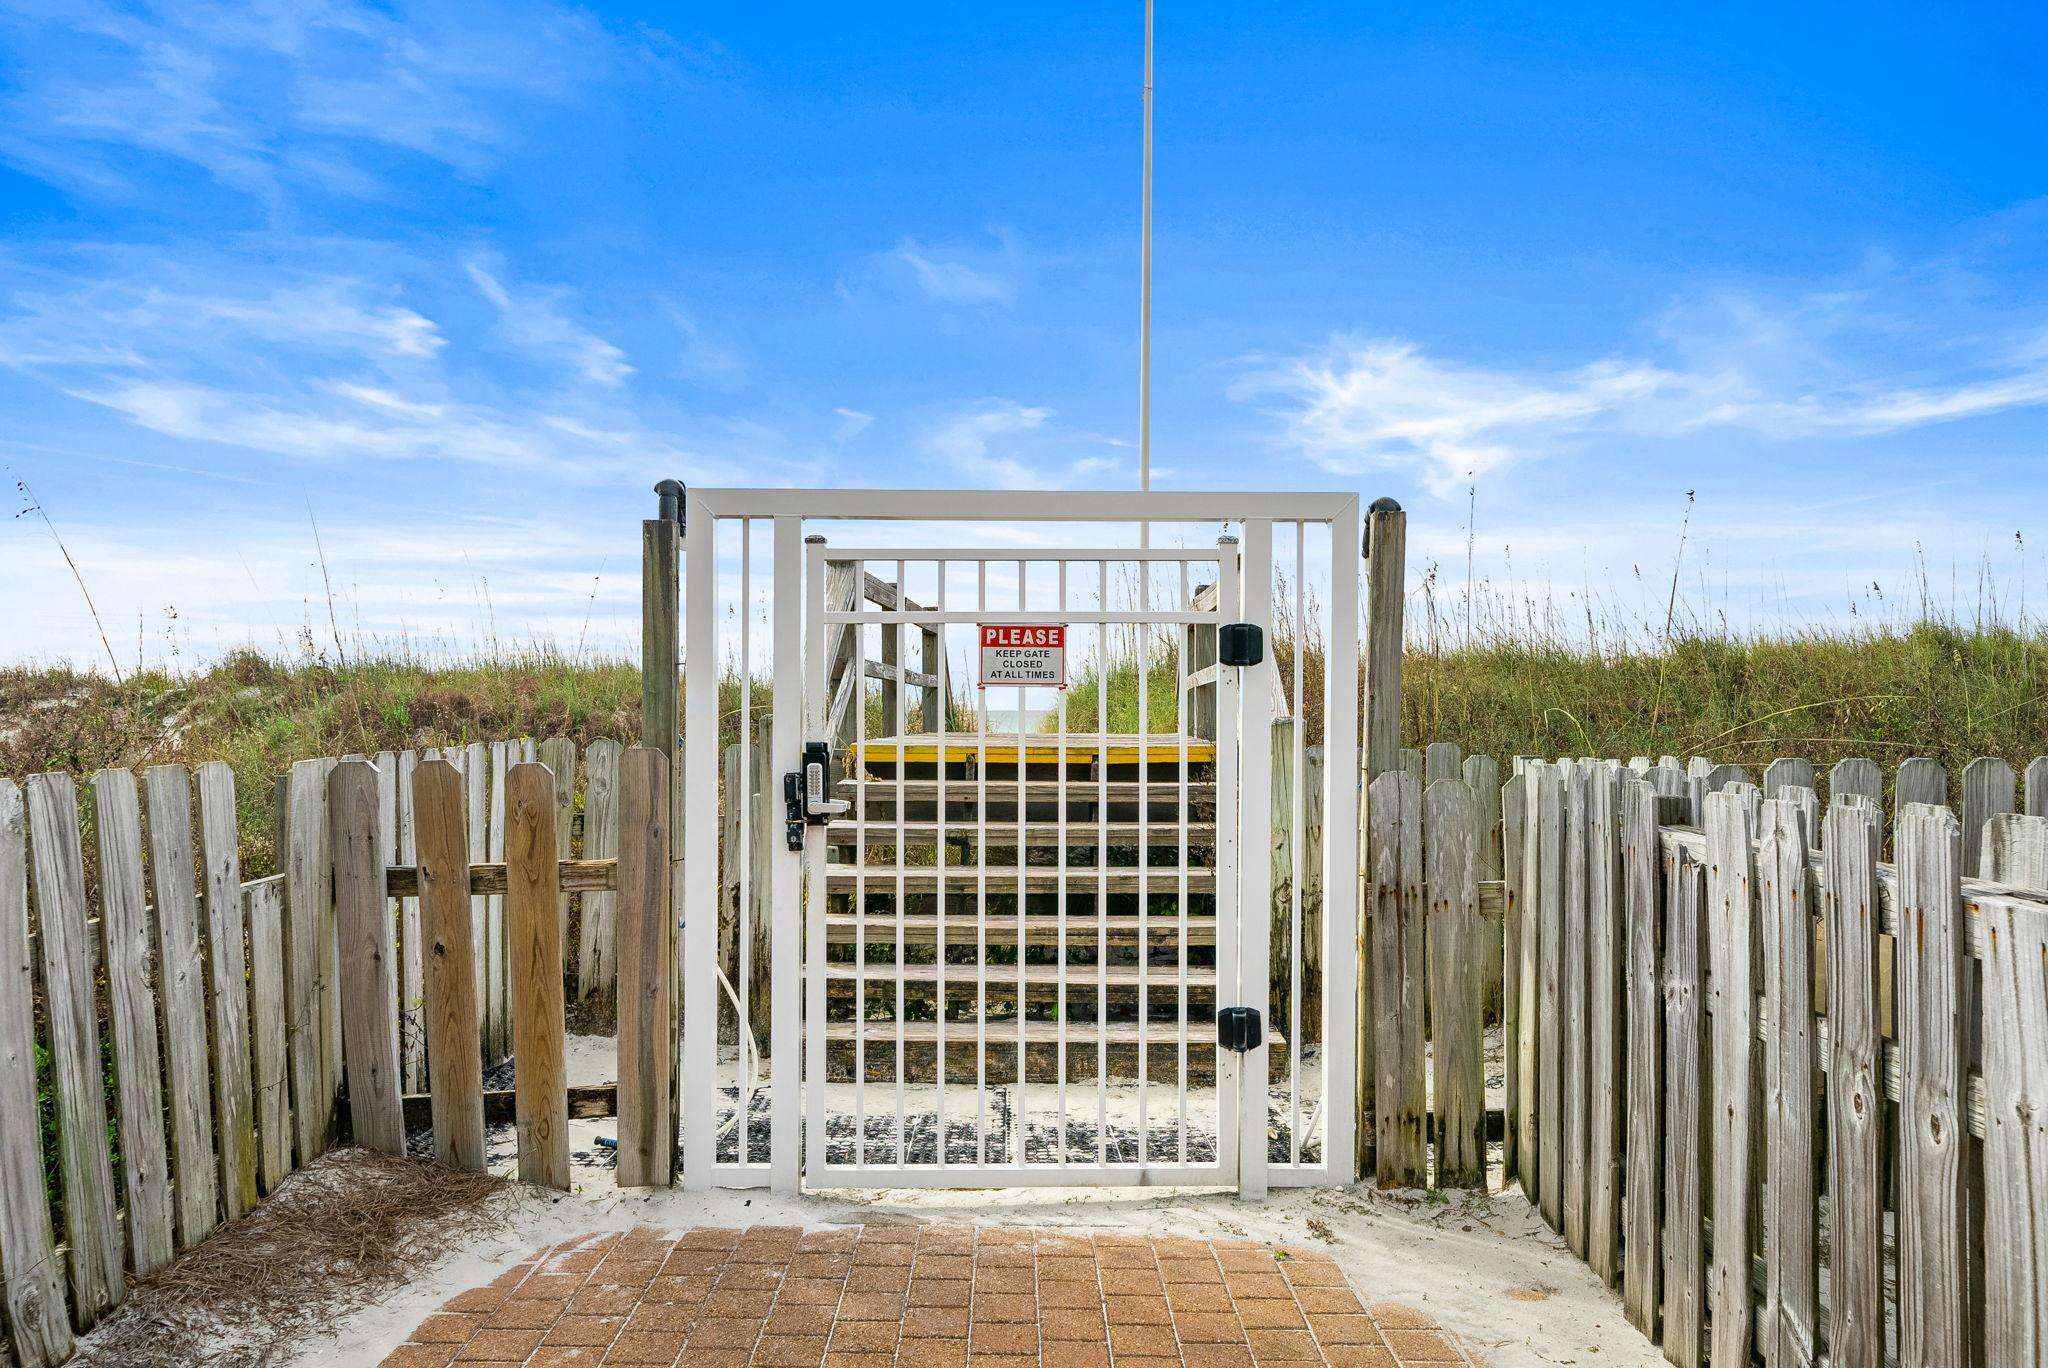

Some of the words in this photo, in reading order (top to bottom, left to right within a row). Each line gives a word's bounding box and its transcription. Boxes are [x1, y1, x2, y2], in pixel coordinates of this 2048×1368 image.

[986, 629, 1059, 645] PLEASE
[995, 650, 1022, 658] KEEP
[1024, 650, 1050, 658] GATE
[1002, 660, 1043, 668] CLOSED
[990, 670, 1003, 679] AT
[1004, 670, 1023, 679] ALL
[1025, 670, 1055, 679] TIMES
